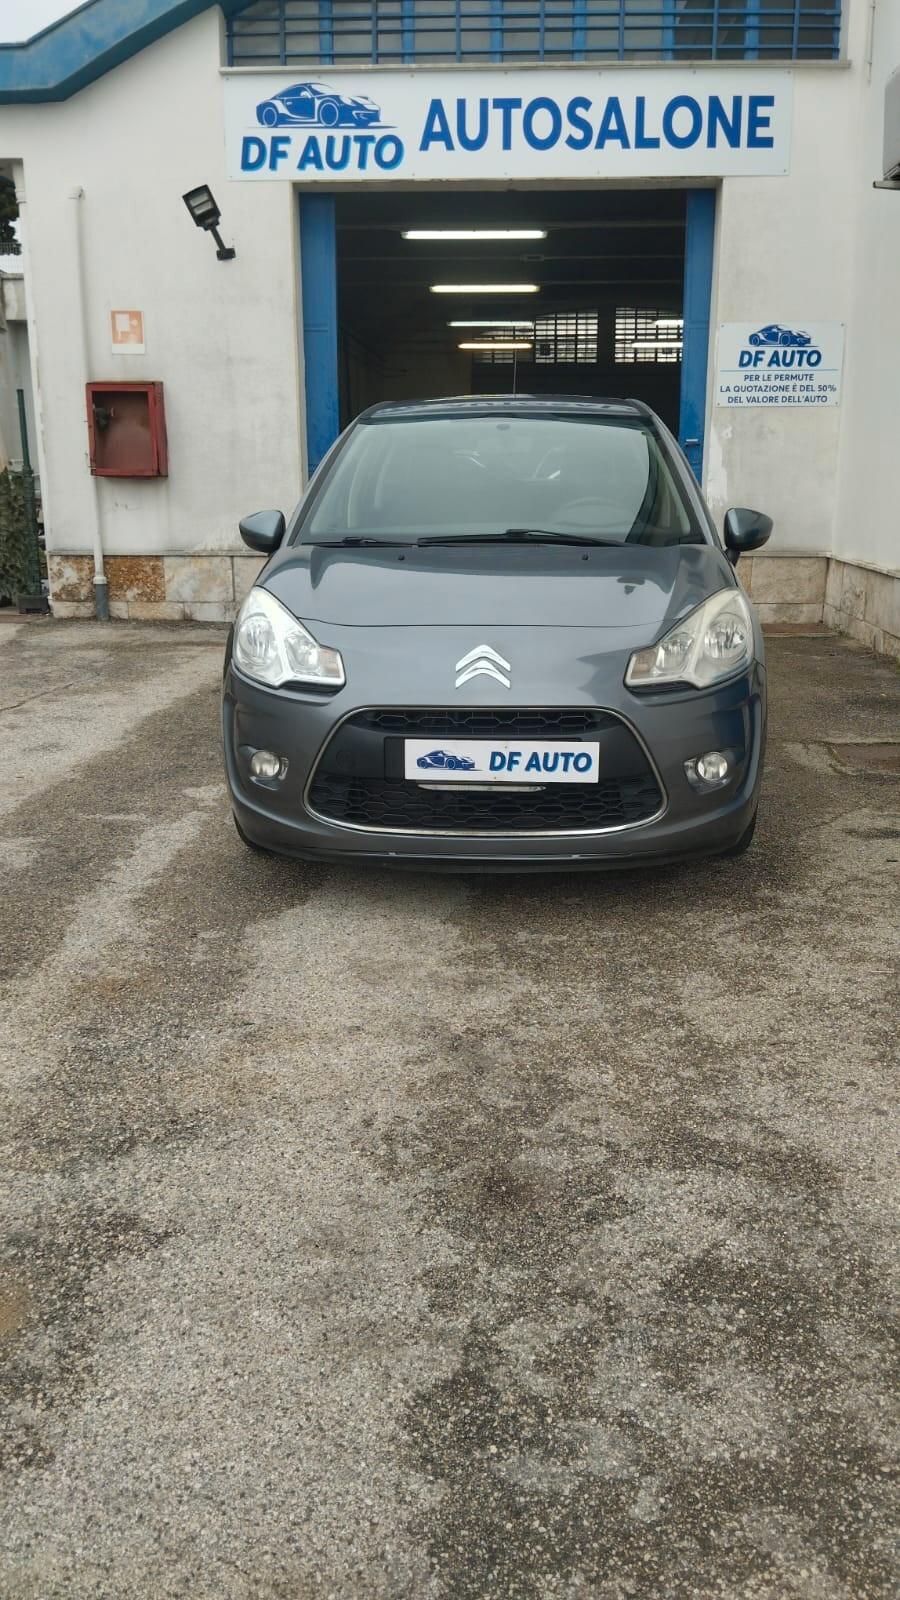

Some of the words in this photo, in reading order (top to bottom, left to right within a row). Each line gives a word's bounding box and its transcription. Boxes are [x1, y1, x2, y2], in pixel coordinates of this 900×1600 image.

[419, 95, 775, 151] AUTOSALONE
[240, 136, 291, 171] DF
[298, 134, 404, 170] AUTO
[738, 350, 766, 368] DF
[767, 349, 822, 368] AUTO
[744, 374, 760, 382] PER
[774, 373, 815, 381] PERMUTE
[720, 385, 731, 393] LA
[733, 384, 790, 393] QUOTAZIONE
[792, 382, 798, 393] È
[800, 384, 815, 392] DEL
[818, 384, 837, 392] 50%
[727, 396, 743, 404] DEL
[746, 395, 779, 404] VALORE
[781, 395, 828, 403] DELL'AUTO
[489, 751, 521, 772] DF
[524, 752, 593, 773] AUTO
